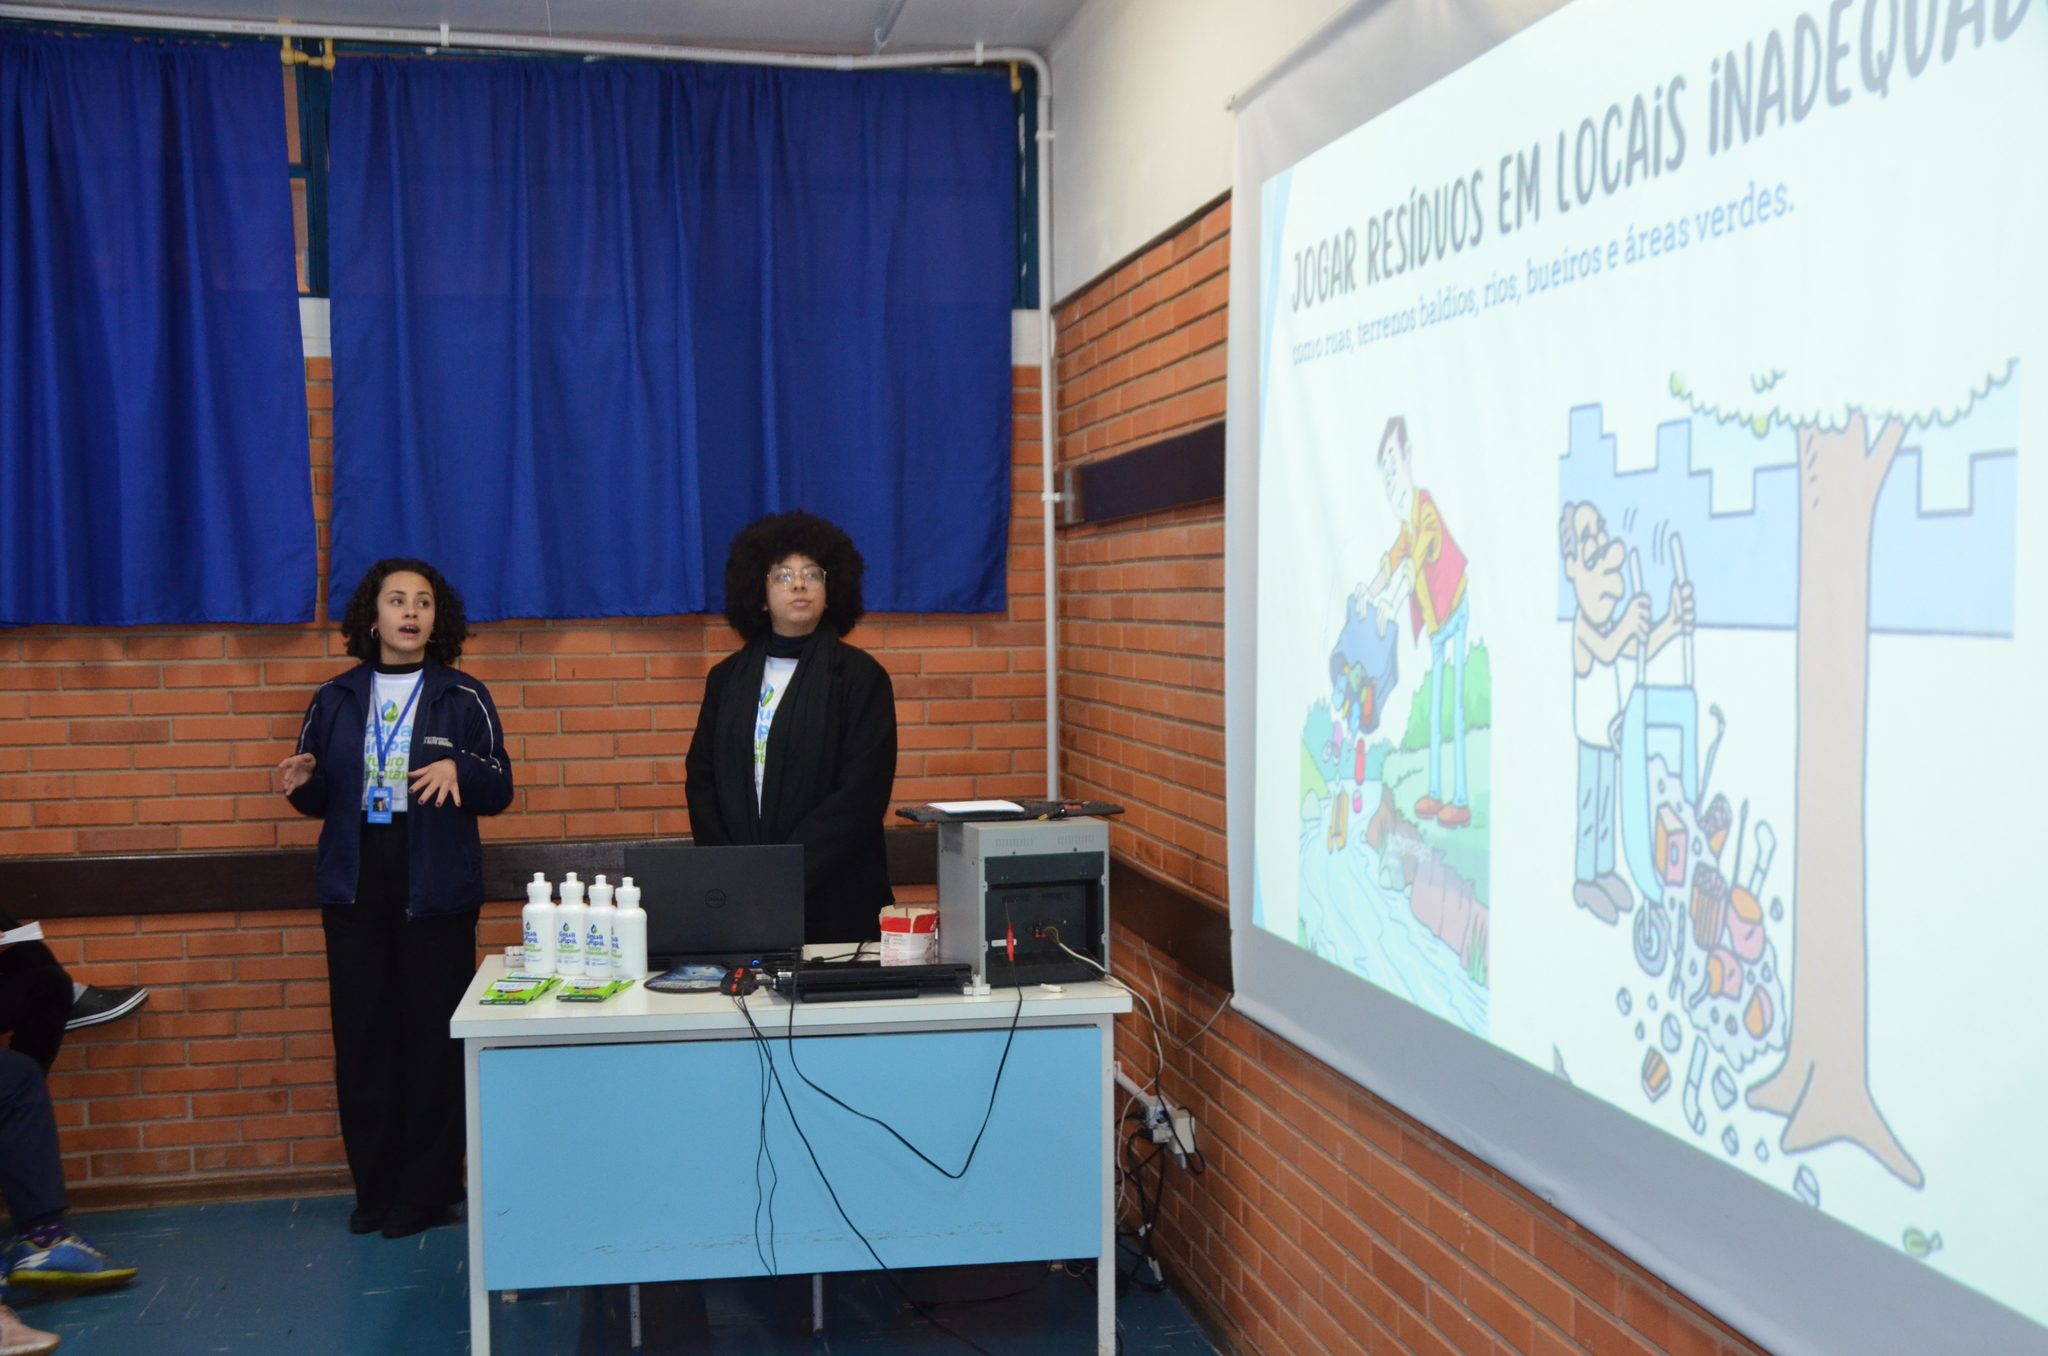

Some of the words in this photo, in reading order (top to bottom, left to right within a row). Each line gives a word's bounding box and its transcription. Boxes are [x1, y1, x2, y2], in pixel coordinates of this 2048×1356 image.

[1292, 226, 1357, 313] JOGAR
[1367, 167, 1484, 286] RESÍDUOS
[1498, 141, 1541, 236] EM
[1292, 335, 1322, 366] como
[1324, 327, 1356, 356] ruas,
[1357, 312, 1417, 346] terrenos
[1419, 285, 1480, 328] baldios,
[1483, 270, 1522, 310] rios,
[1526, 247, 1602, 296] bueiros
[1606, 239, 1619, 270] e
[1624, 216, 1691, 266] áreas
[1695, 180, 1796, 242] verdes.
